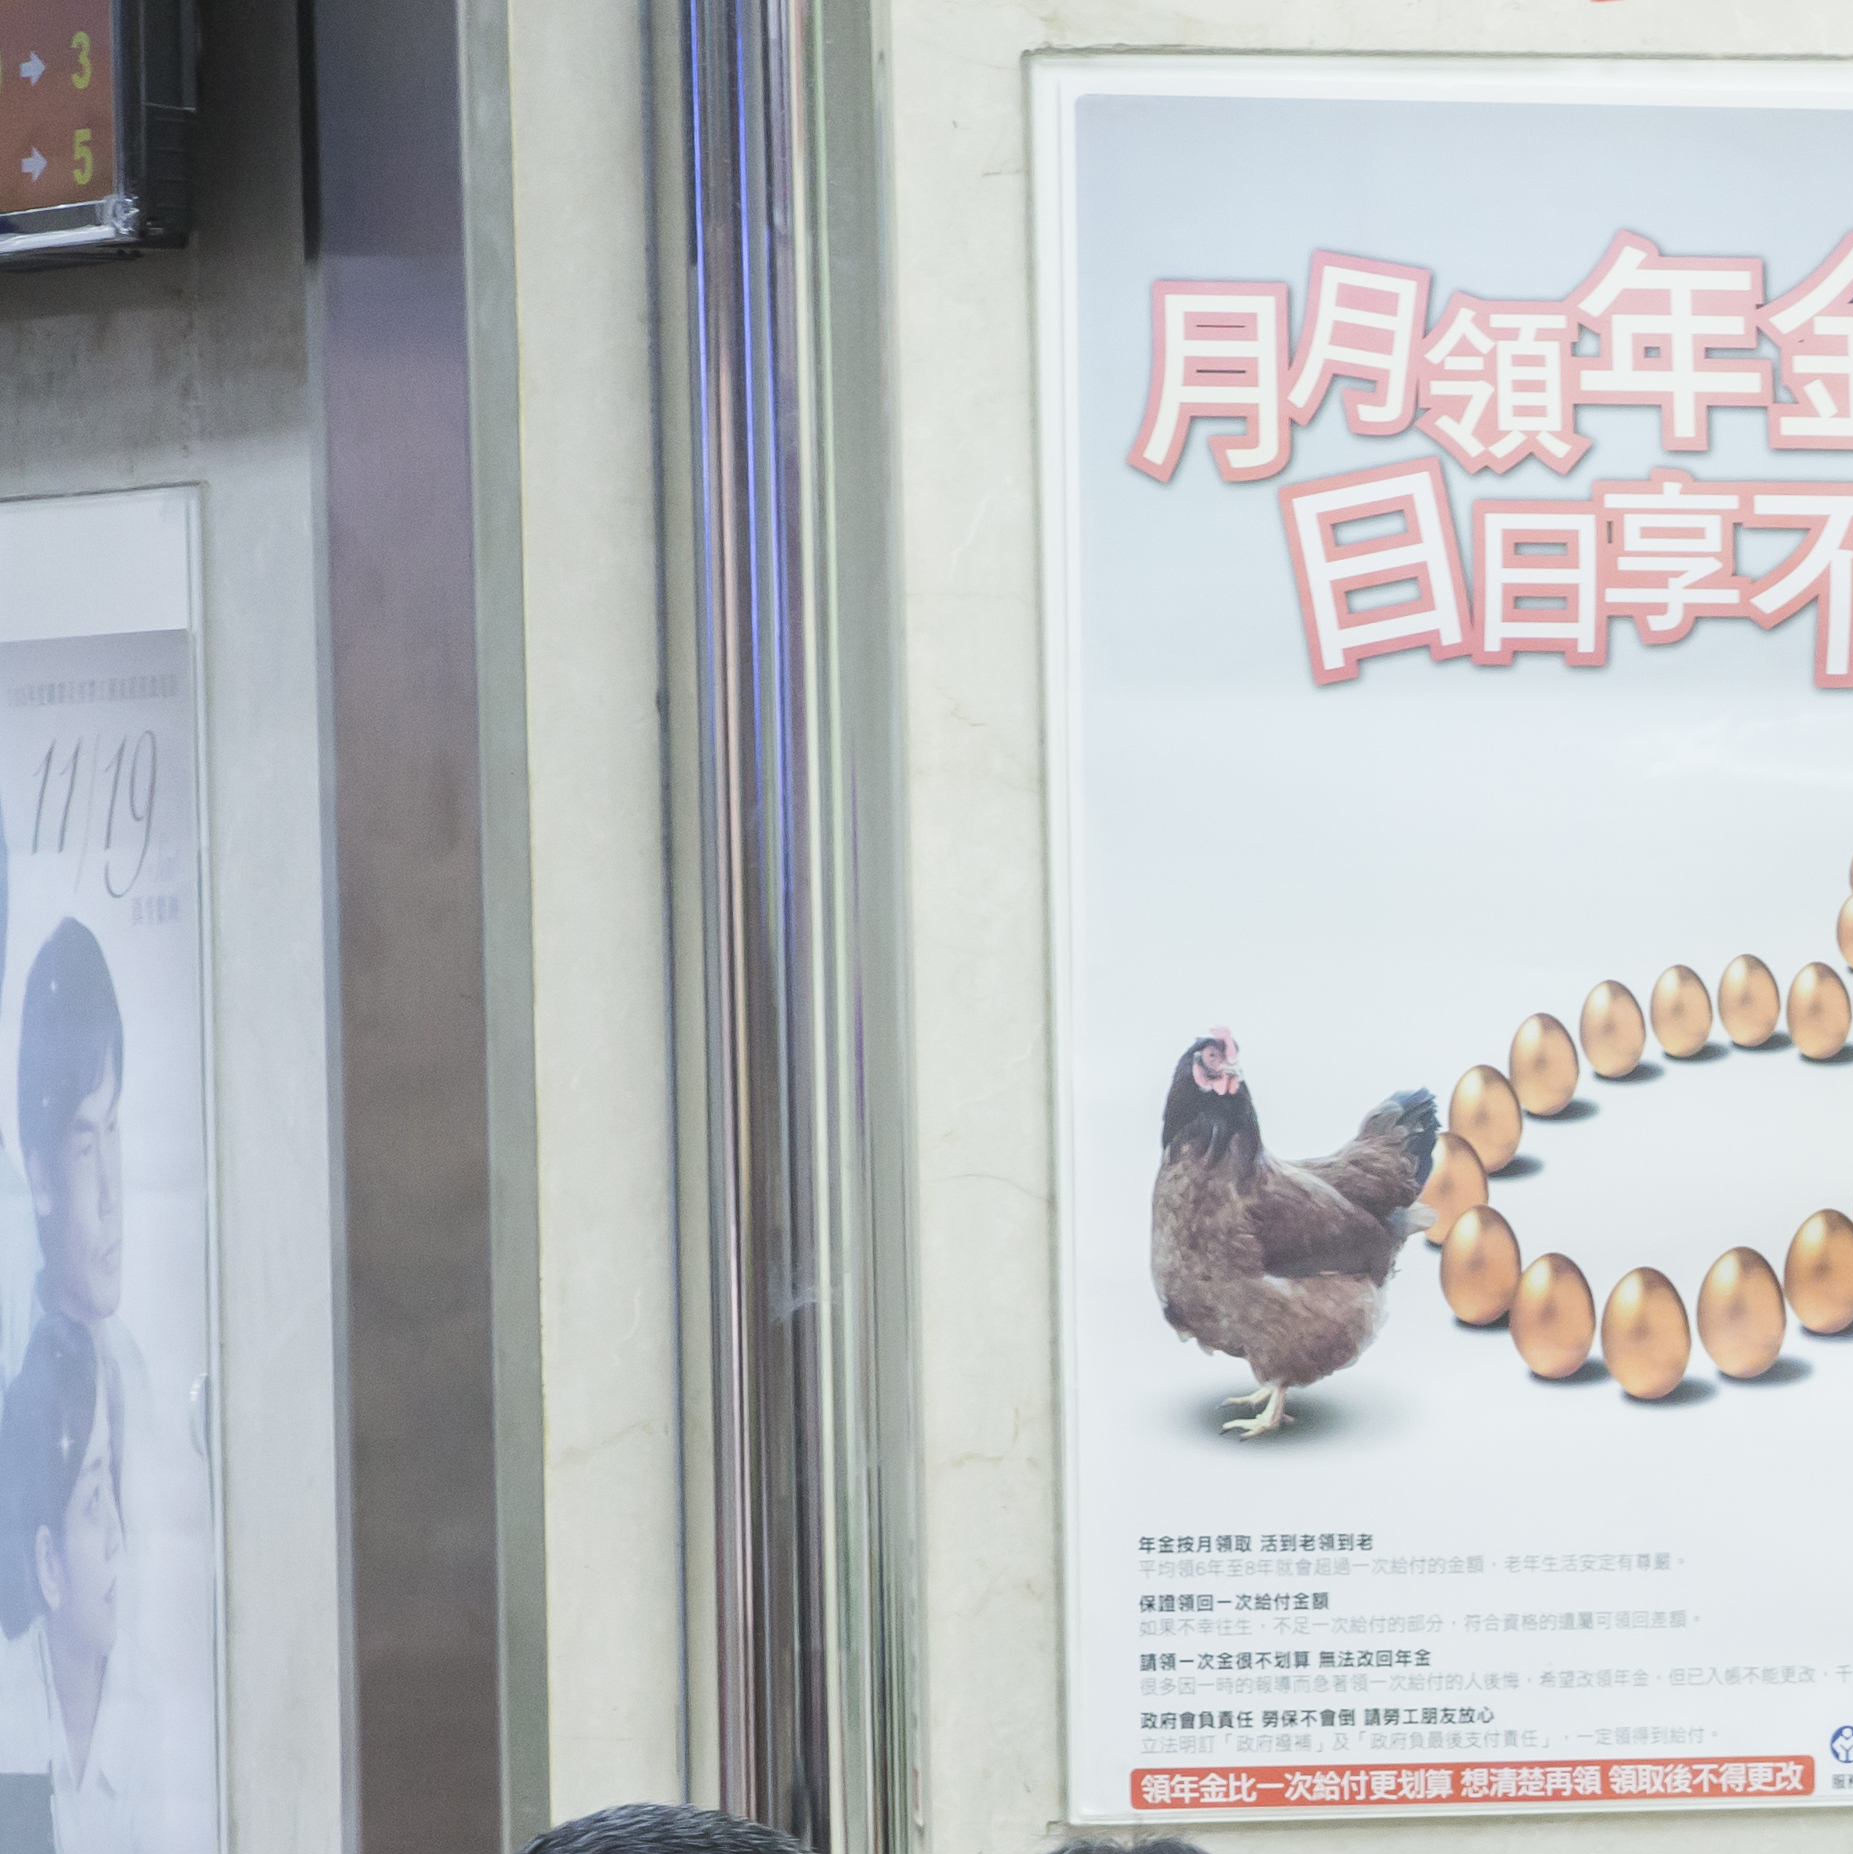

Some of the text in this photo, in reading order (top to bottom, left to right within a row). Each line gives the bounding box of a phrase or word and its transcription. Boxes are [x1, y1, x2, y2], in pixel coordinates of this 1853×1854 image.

[71, 31, 92, 90] 3
[73, 128, 94, 185] 5
[1138, 1533, 1374, 1553] 年金按月領取 活到老領到老
[1139, 1591, 1330, 1613] 保證領回一次給付金額
[1140, 1648, 1431, 1672] 請領一次金很不划算 無法改回年金
[1140, 1706, 1494, 1731] 政府會負責任 勞保不會倒 請勞工朋友放心
[1141, 1761, 1805, 1804] 領年金比一次給付更划算 想清楚再領 領取後不得更改
